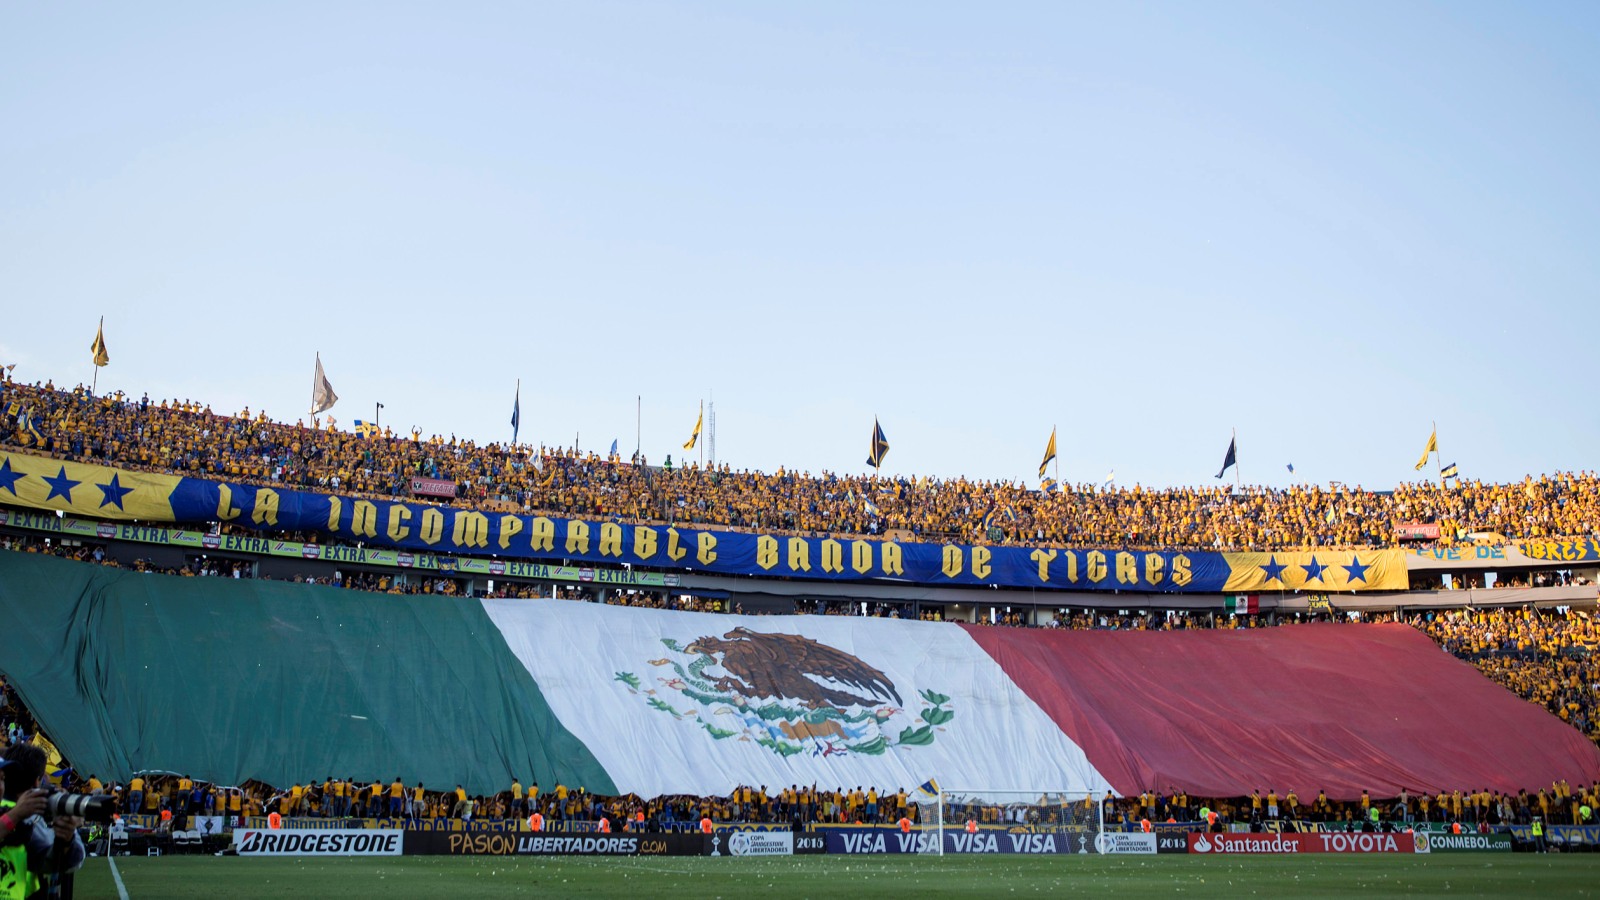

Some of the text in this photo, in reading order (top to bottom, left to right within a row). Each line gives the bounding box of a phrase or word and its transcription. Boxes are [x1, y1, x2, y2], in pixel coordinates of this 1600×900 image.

[13, 511, 62, 531] EXTRA
[121, 525, 169, 543] EXTRA
[216, 482, 280, 526] LA
[327, 495, 718, 566] INCOMPARABLE
[756, 534, 904, 576] BANDA
[941, 544, 992, 580] DE
[1030, 548, 1193, 586] TIGRES
[225, 535, 270, 553] EXTRA
[324, 547, 367, 562] EXTRA
[509, 561, 549, 577] EXTRA
[598, 569, 637, 583] EXTRA
[239, 831, 399, 852] BRIDGESTONE
[518, 837, 638, 853] LIBERTADORES
[796, 837, 824, 849] 2015
[839, 833, 887, 853] VISA
[894, 833, 942, 853] VISA
[949, 833, 999, 853] VISA
[1007, 833, 1057, 853] VISA
[1159, 838, 1186, 849] 2015
[1214, 833, 1299, 853] Santander
[1319, 834, 1399, 852] TOYOTA
[1430, 836, 1511, 849] CONMEBOL.com
